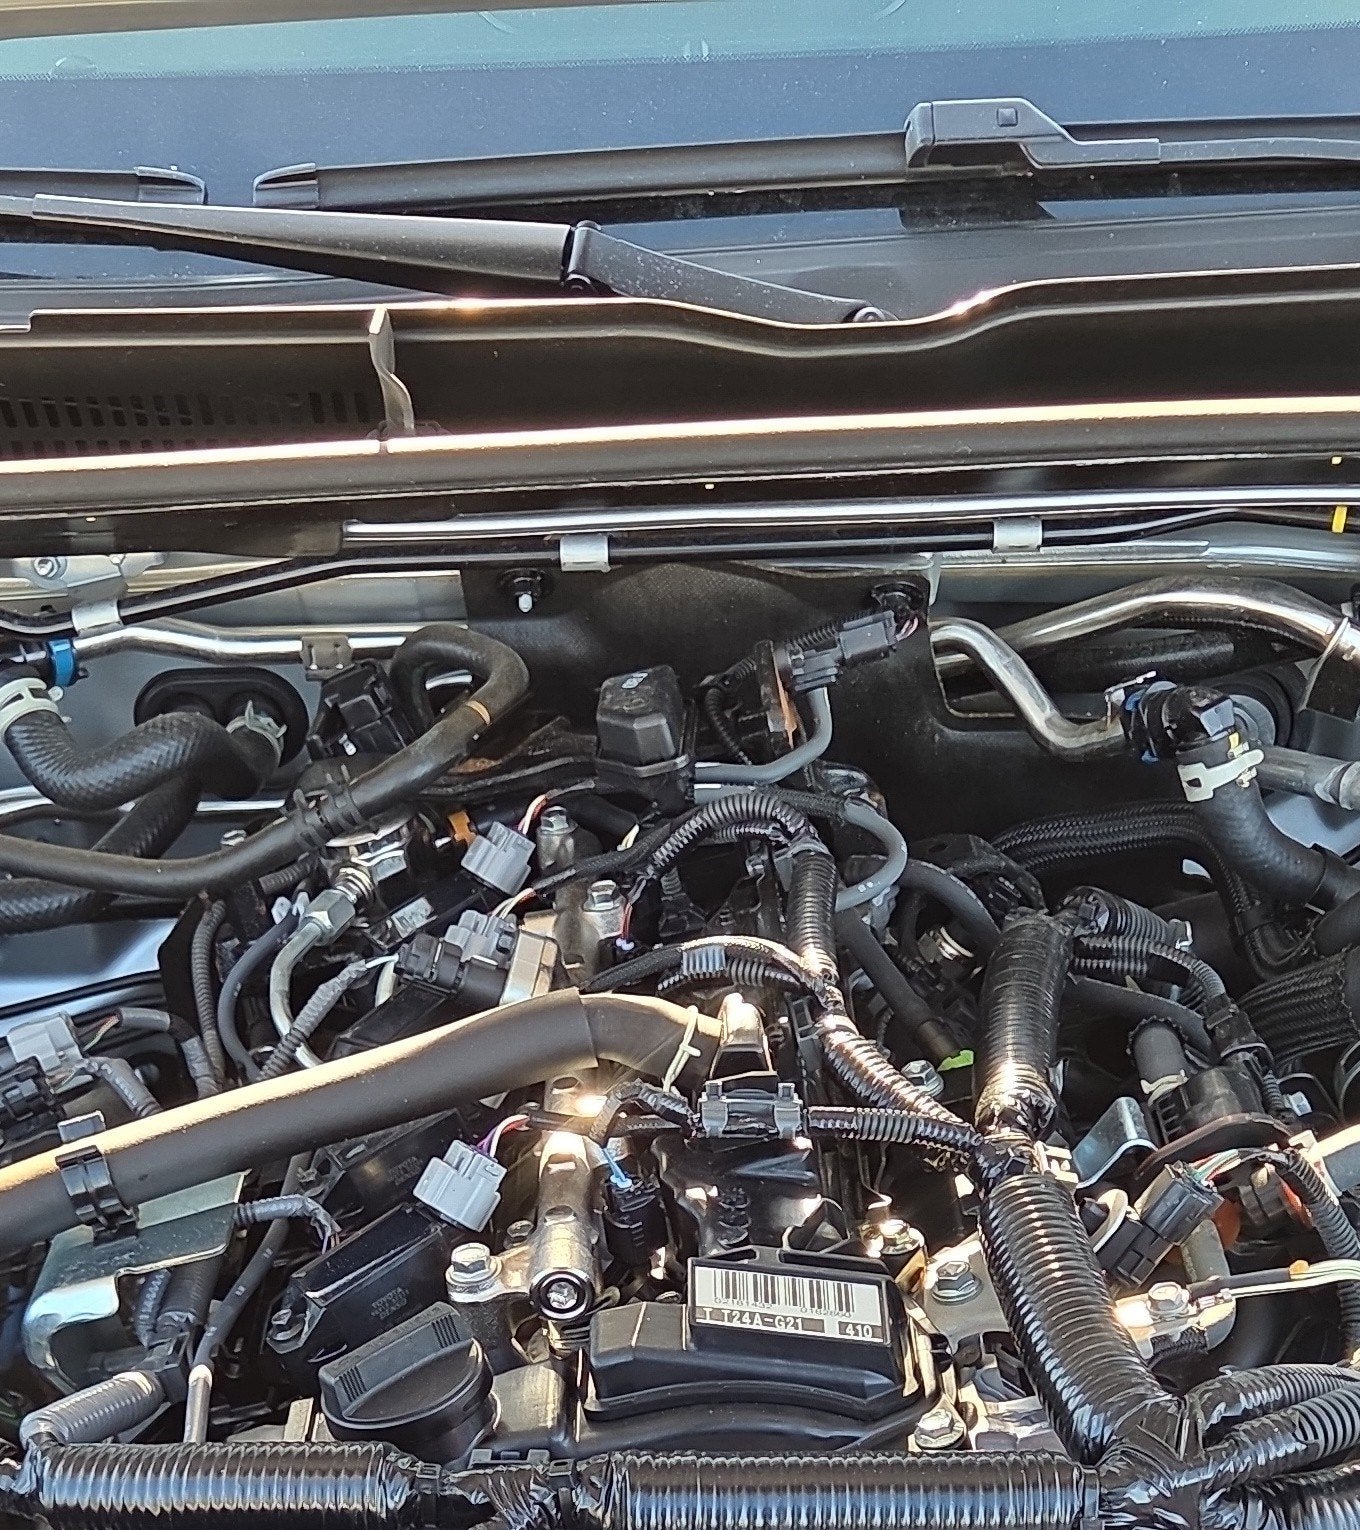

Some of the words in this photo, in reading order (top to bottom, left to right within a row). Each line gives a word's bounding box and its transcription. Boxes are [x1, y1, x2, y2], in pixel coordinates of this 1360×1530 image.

[703, 1308, 713, 1320] T
[722, 1309, 803, 1331] T24A-G21
[846, 1323, 873, 1338] 410
